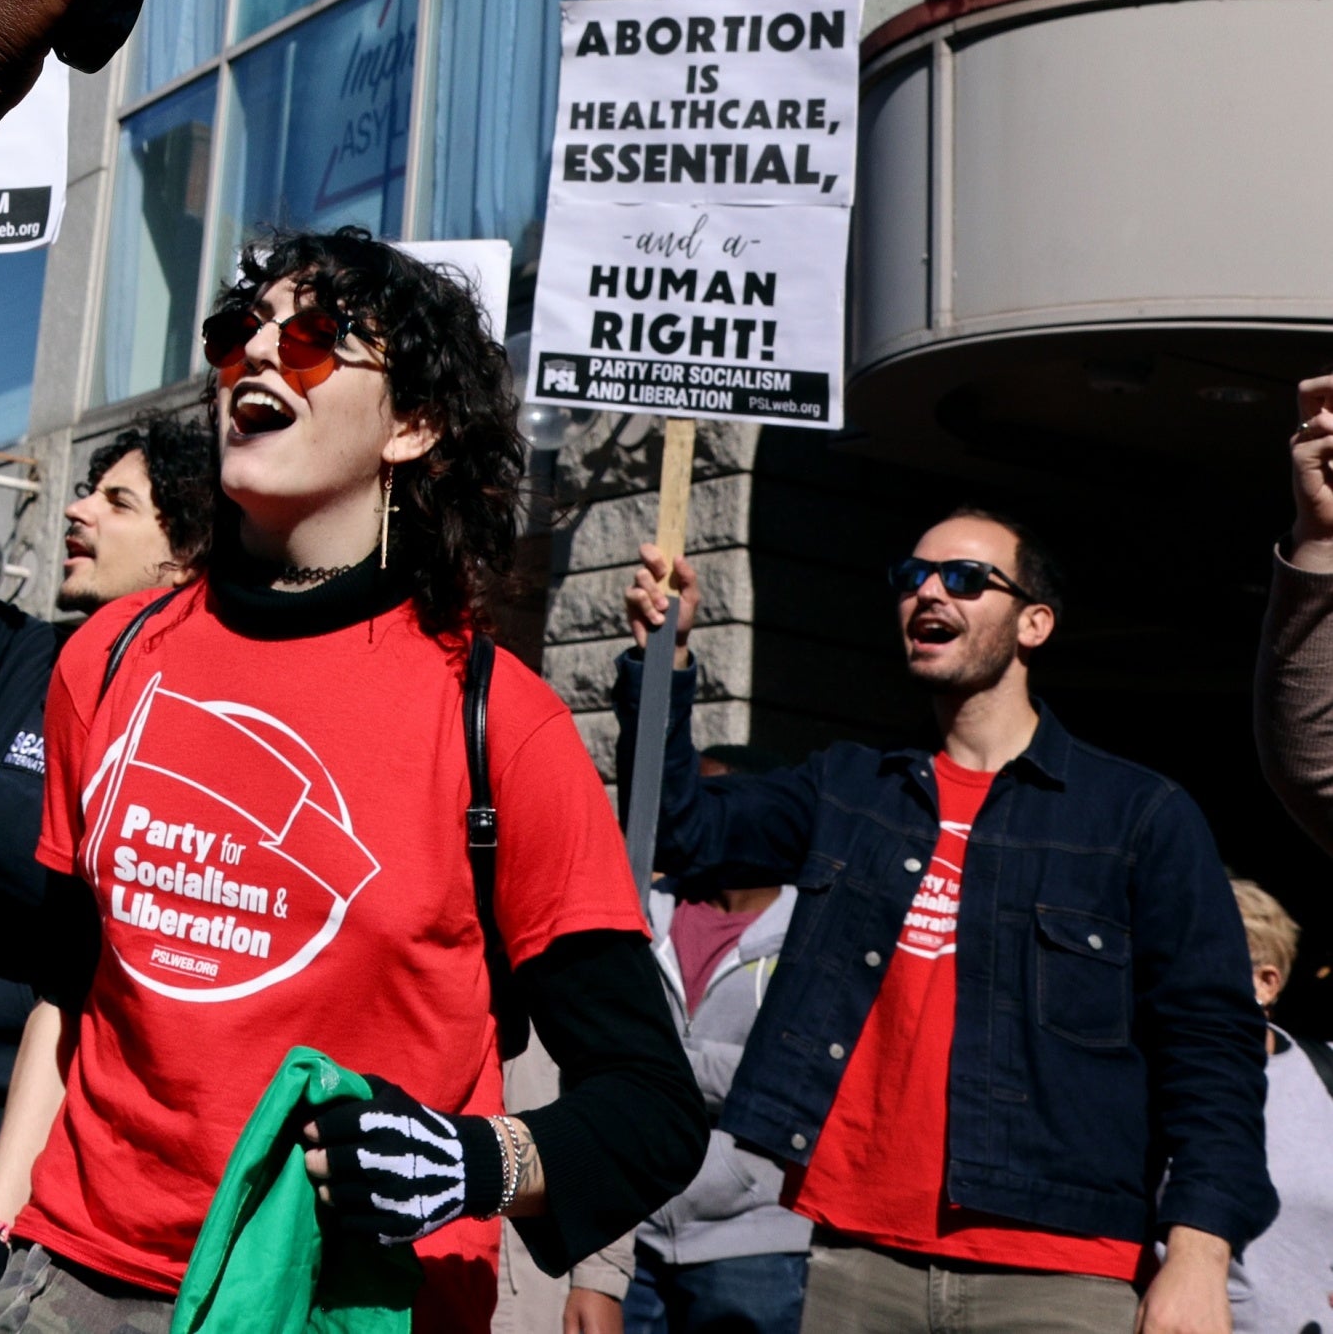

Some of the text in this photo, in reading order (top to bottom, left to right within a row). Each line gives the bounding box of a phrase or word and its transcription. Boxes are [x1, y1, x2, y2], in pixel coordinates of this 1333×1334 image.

[576, 10, 845, 57] ABORTION
[686, 65, 719, 94] IS
[338, 90, 412, 163] ASYL
[569, 99, 840, 135] HEALTHCARE,
[563, 144, 838, 193] ESSENTIAL,
[589, 265, 776, 307] HUMAN
[591, 310, 776, 361] RIGHT!
[543, 368, 579, 393] PSL
[588, 359, 791, 392] PARTY FOR SOCIALISM
[586, 381, 821, 419] AND LIBERATION PSLweb.org
[120, 804, 246, 866] Party for
[113, 845, 288, 919] Socialism &
[111, 884, 271, 959] Liberation
[150, 948, 219, 977] PSLWEB.ORG
